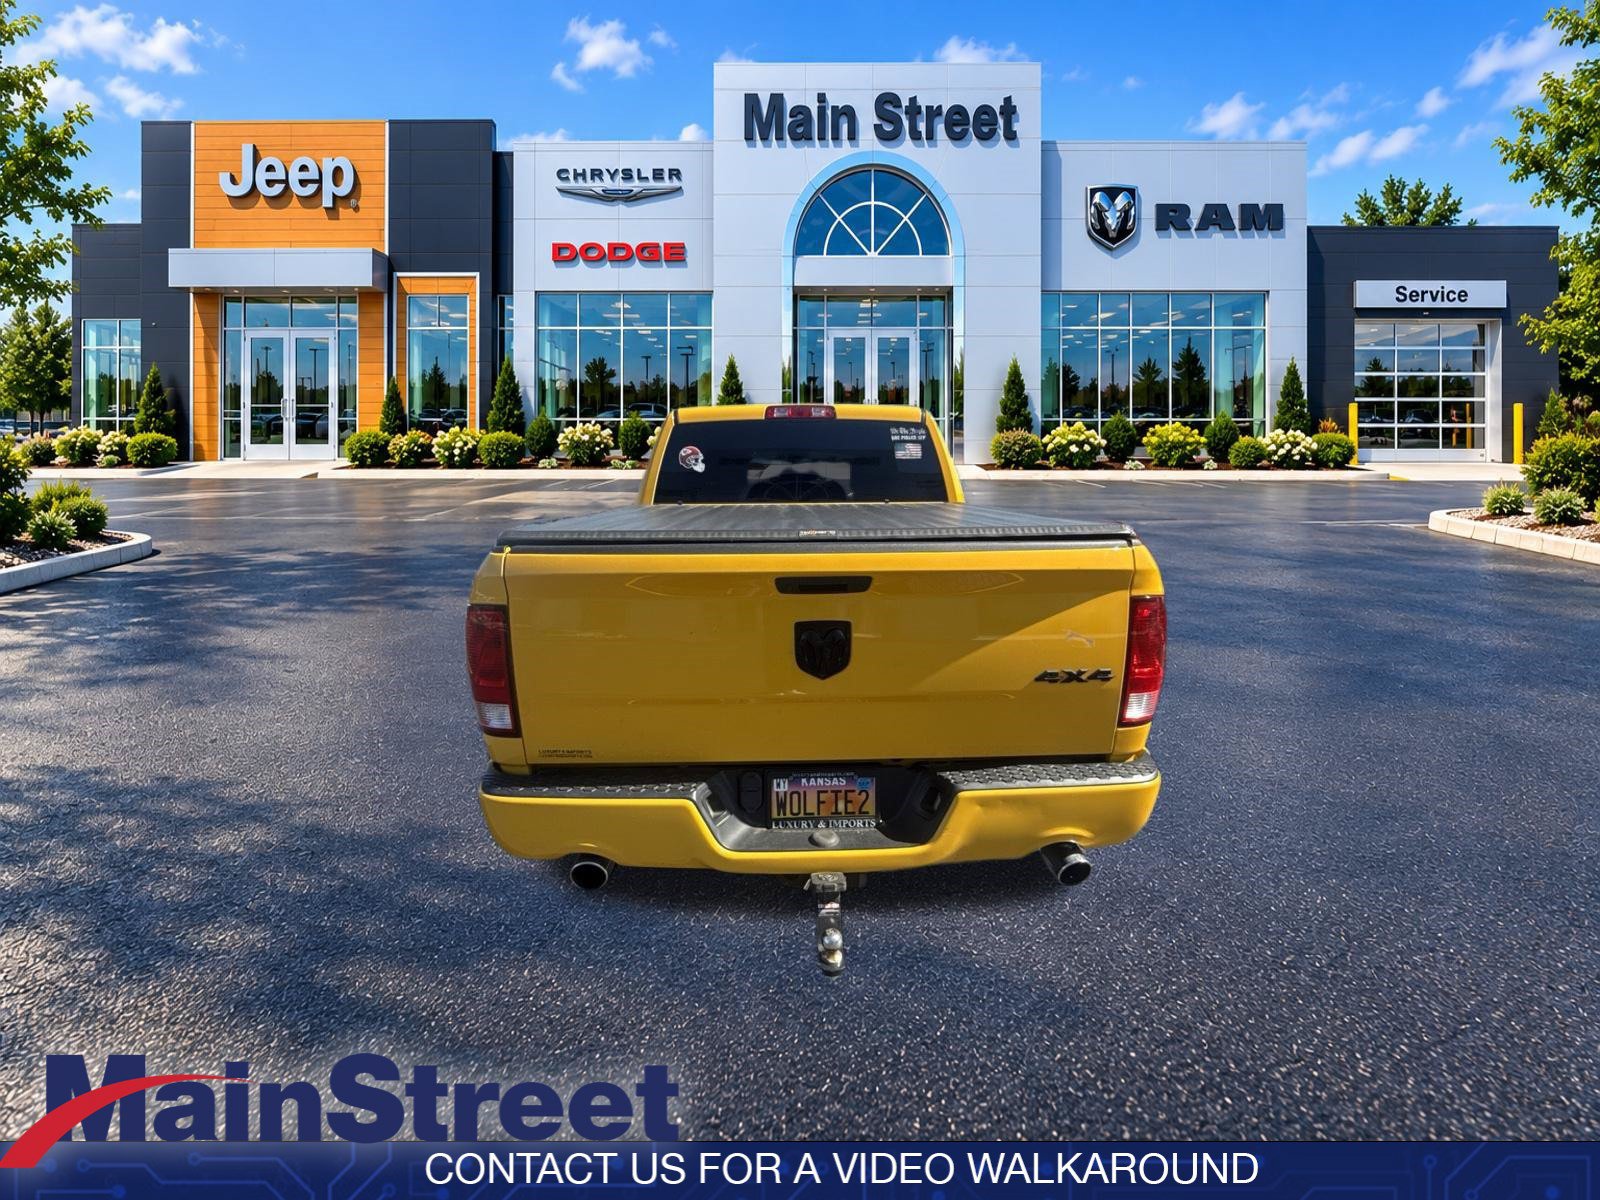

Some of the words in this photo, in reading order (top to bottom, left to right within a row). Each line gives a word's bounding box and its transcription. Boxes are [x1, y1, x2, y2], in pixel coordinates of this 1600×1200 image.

[744, 92, 857, 141] Main
[873, 91, 1018, 141] Street
[218, 143, 355, 208] Jeep
[556, 168, 683, 182] CHRYSLER
[1155, 203, 1284, 231] RAM
[551, 242, 687, 262] DODGE
[1395, 285, 1469, 303] Service
[801, 777, 846, 786] KANSAS
[775, 789, 870, 817] WOLFIE2
[771, 819, 815, 829] LUXURY
[817, 819, 826, 829] &
[828, 819, 877, 829] IMPORTS
